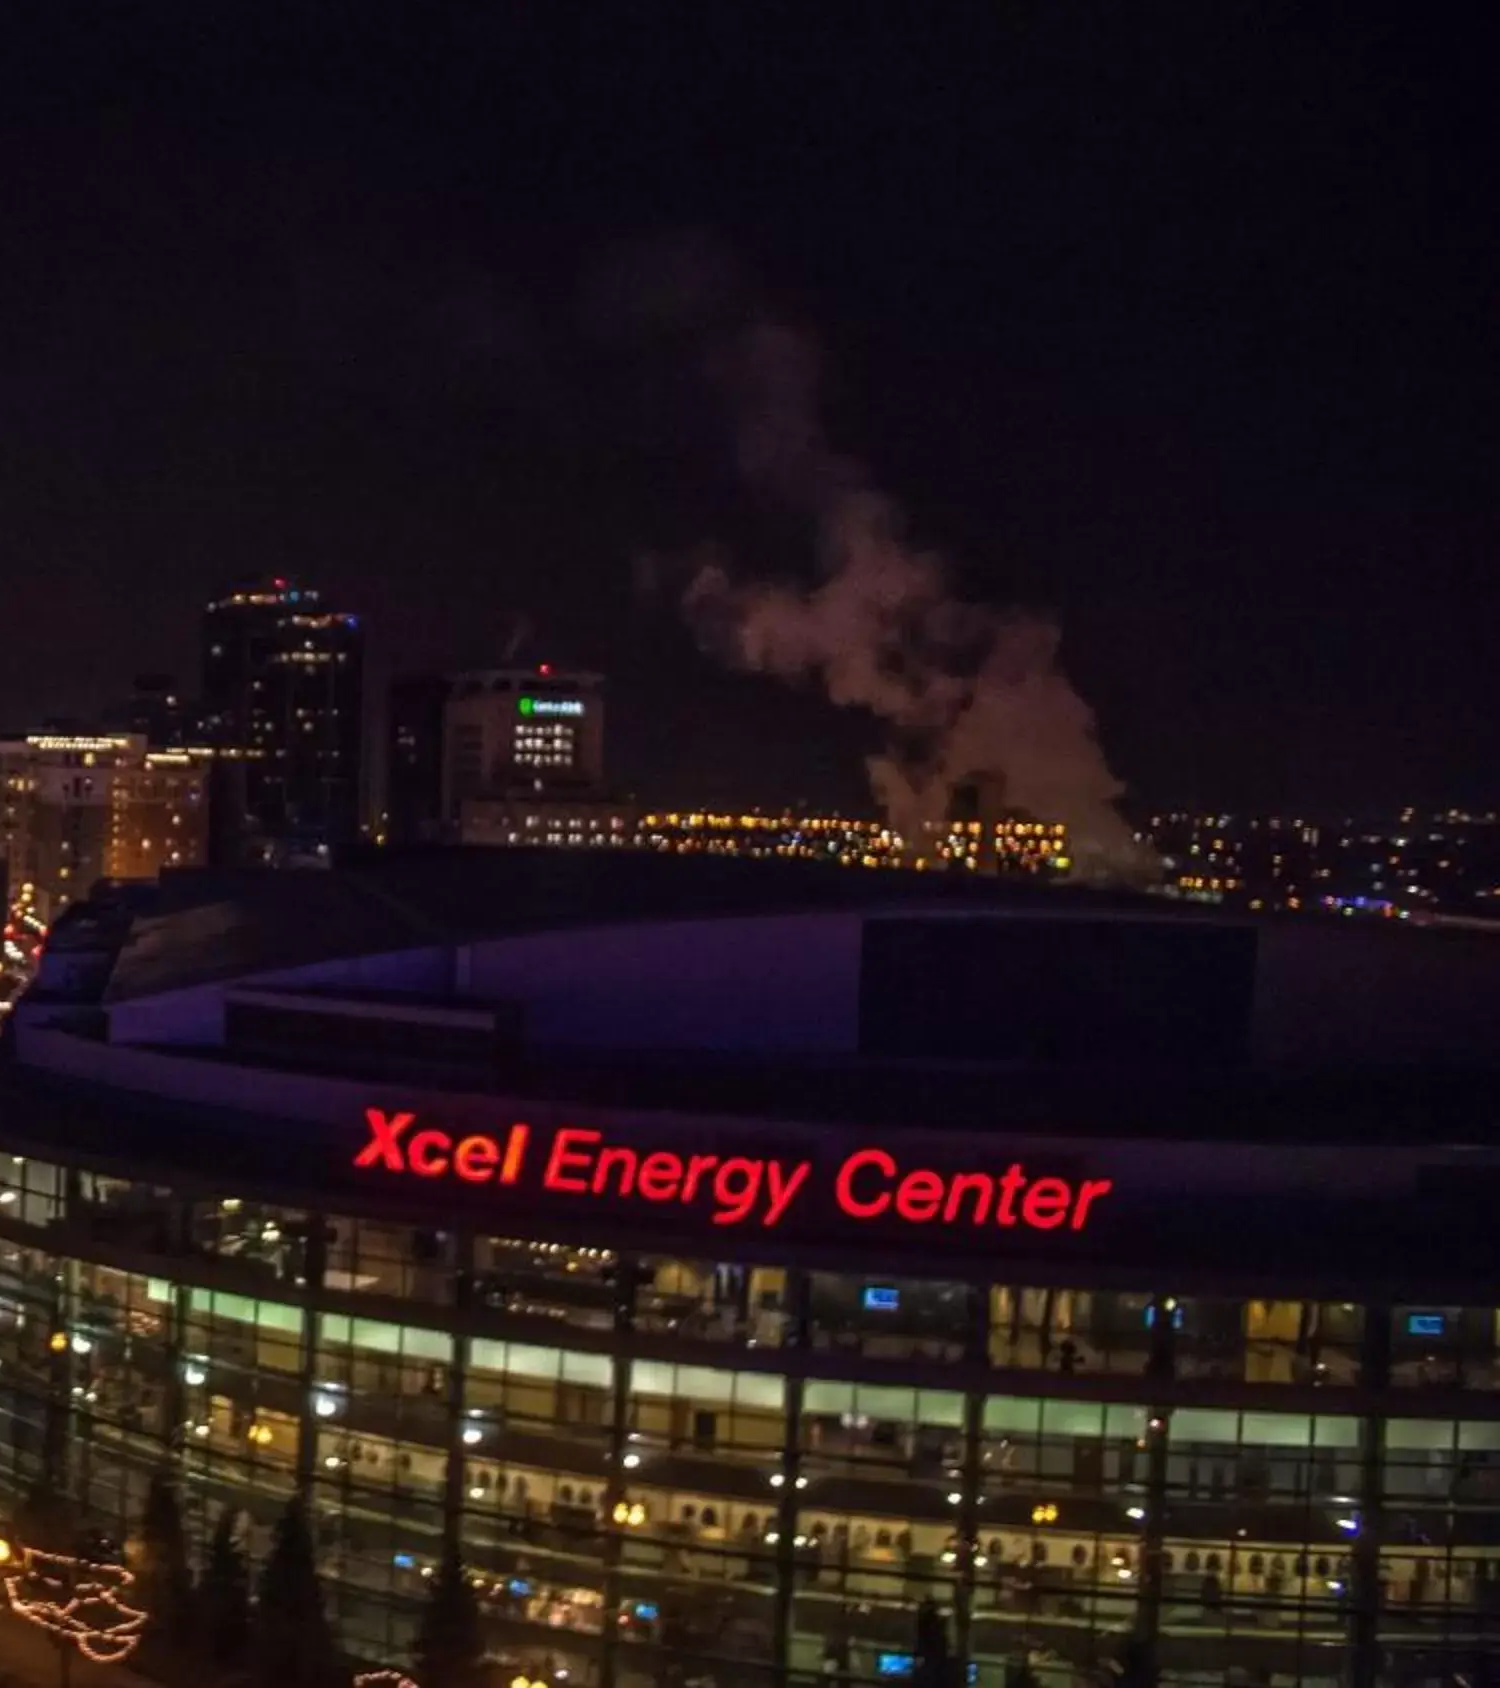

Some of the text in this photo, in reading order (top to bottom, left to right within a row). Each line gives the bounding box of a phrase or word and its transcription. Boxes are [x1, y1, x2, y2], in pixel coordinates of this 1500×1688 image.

[353, 1107, 1113, 1231] Xcel Energy Center
